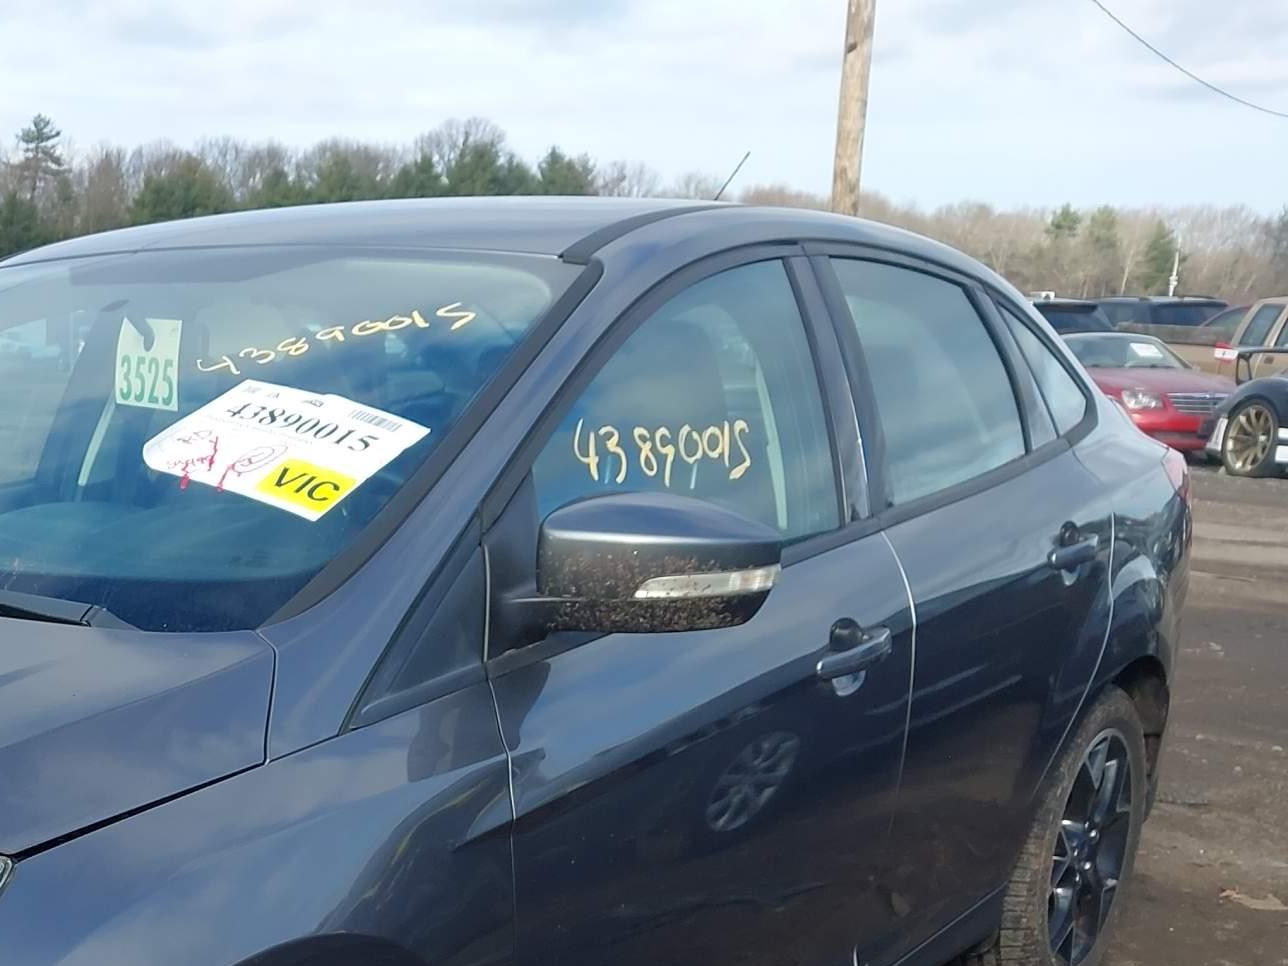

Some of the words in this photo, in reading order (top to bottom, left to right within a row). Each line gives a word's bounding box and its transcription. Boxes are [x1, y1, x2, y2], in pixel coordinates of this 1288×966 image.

[196, 301, 477, 374] 43890015
[119, 354, 174, 406] 3525
[225, 402, 380, 452] 43890015
[574, 417, 752, 488] 43890015
[274, 466, 341, 502] VIC
